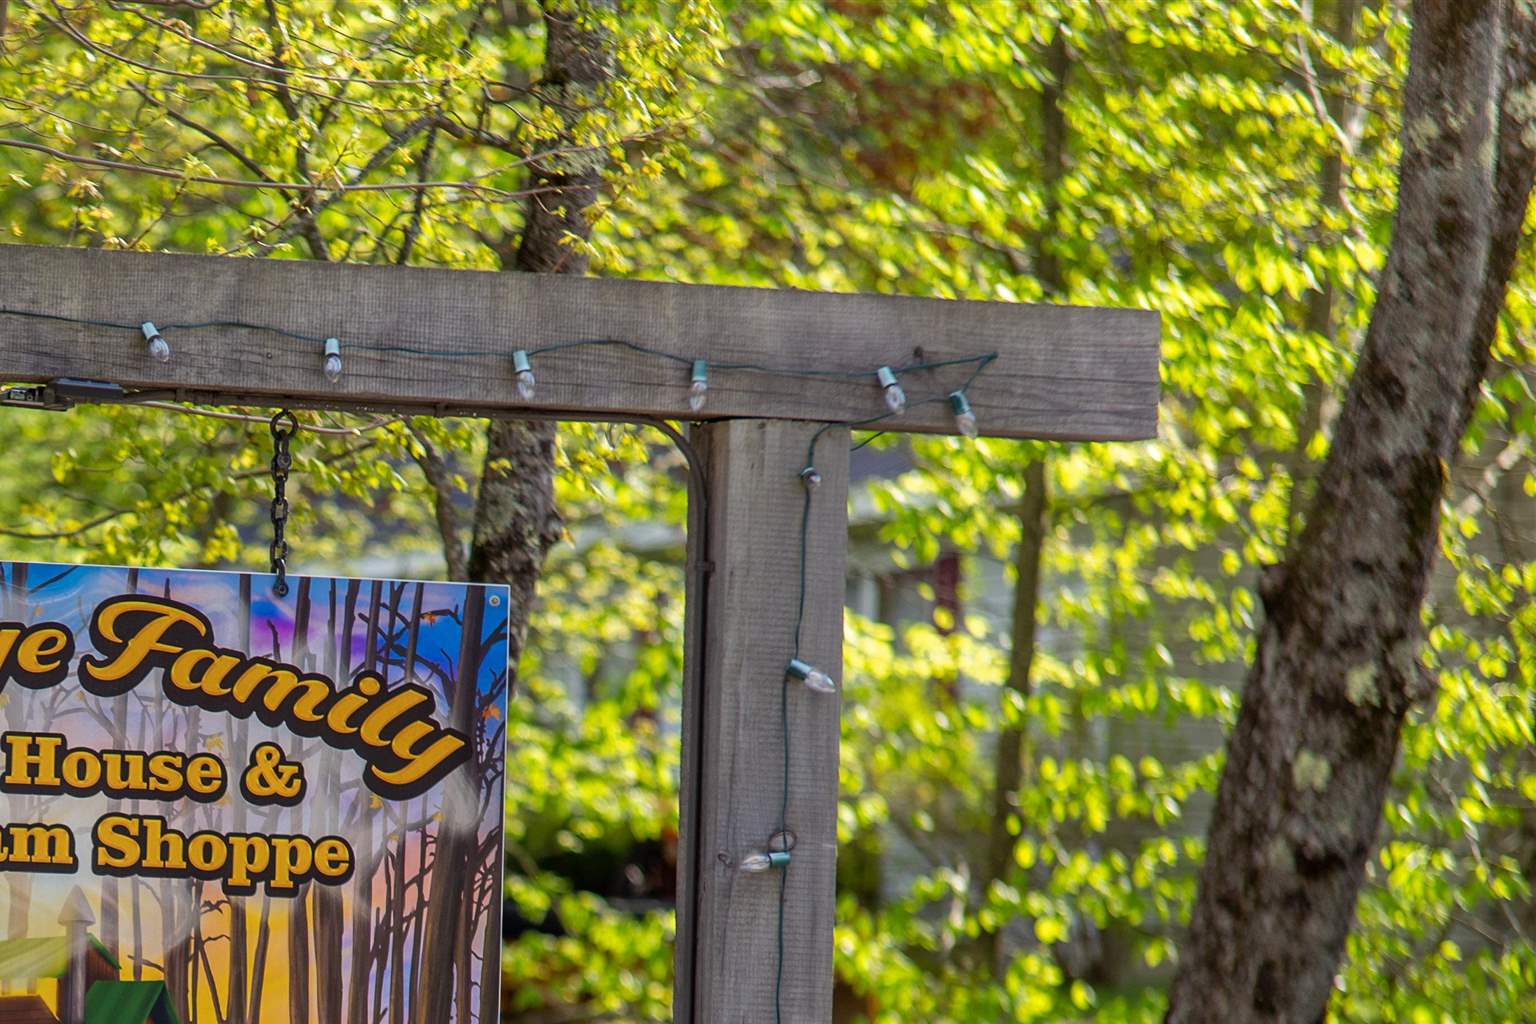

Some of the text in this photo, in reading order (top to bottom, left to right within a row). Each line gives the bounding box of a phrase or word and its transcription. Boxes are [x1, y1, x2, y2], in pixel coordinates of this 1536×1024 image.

[87, 597, 465, 785] Family
[5, 735, 223, 793] House
[245, 744, 302, 798] &
[97, 816, 350, 889] Shoppe
